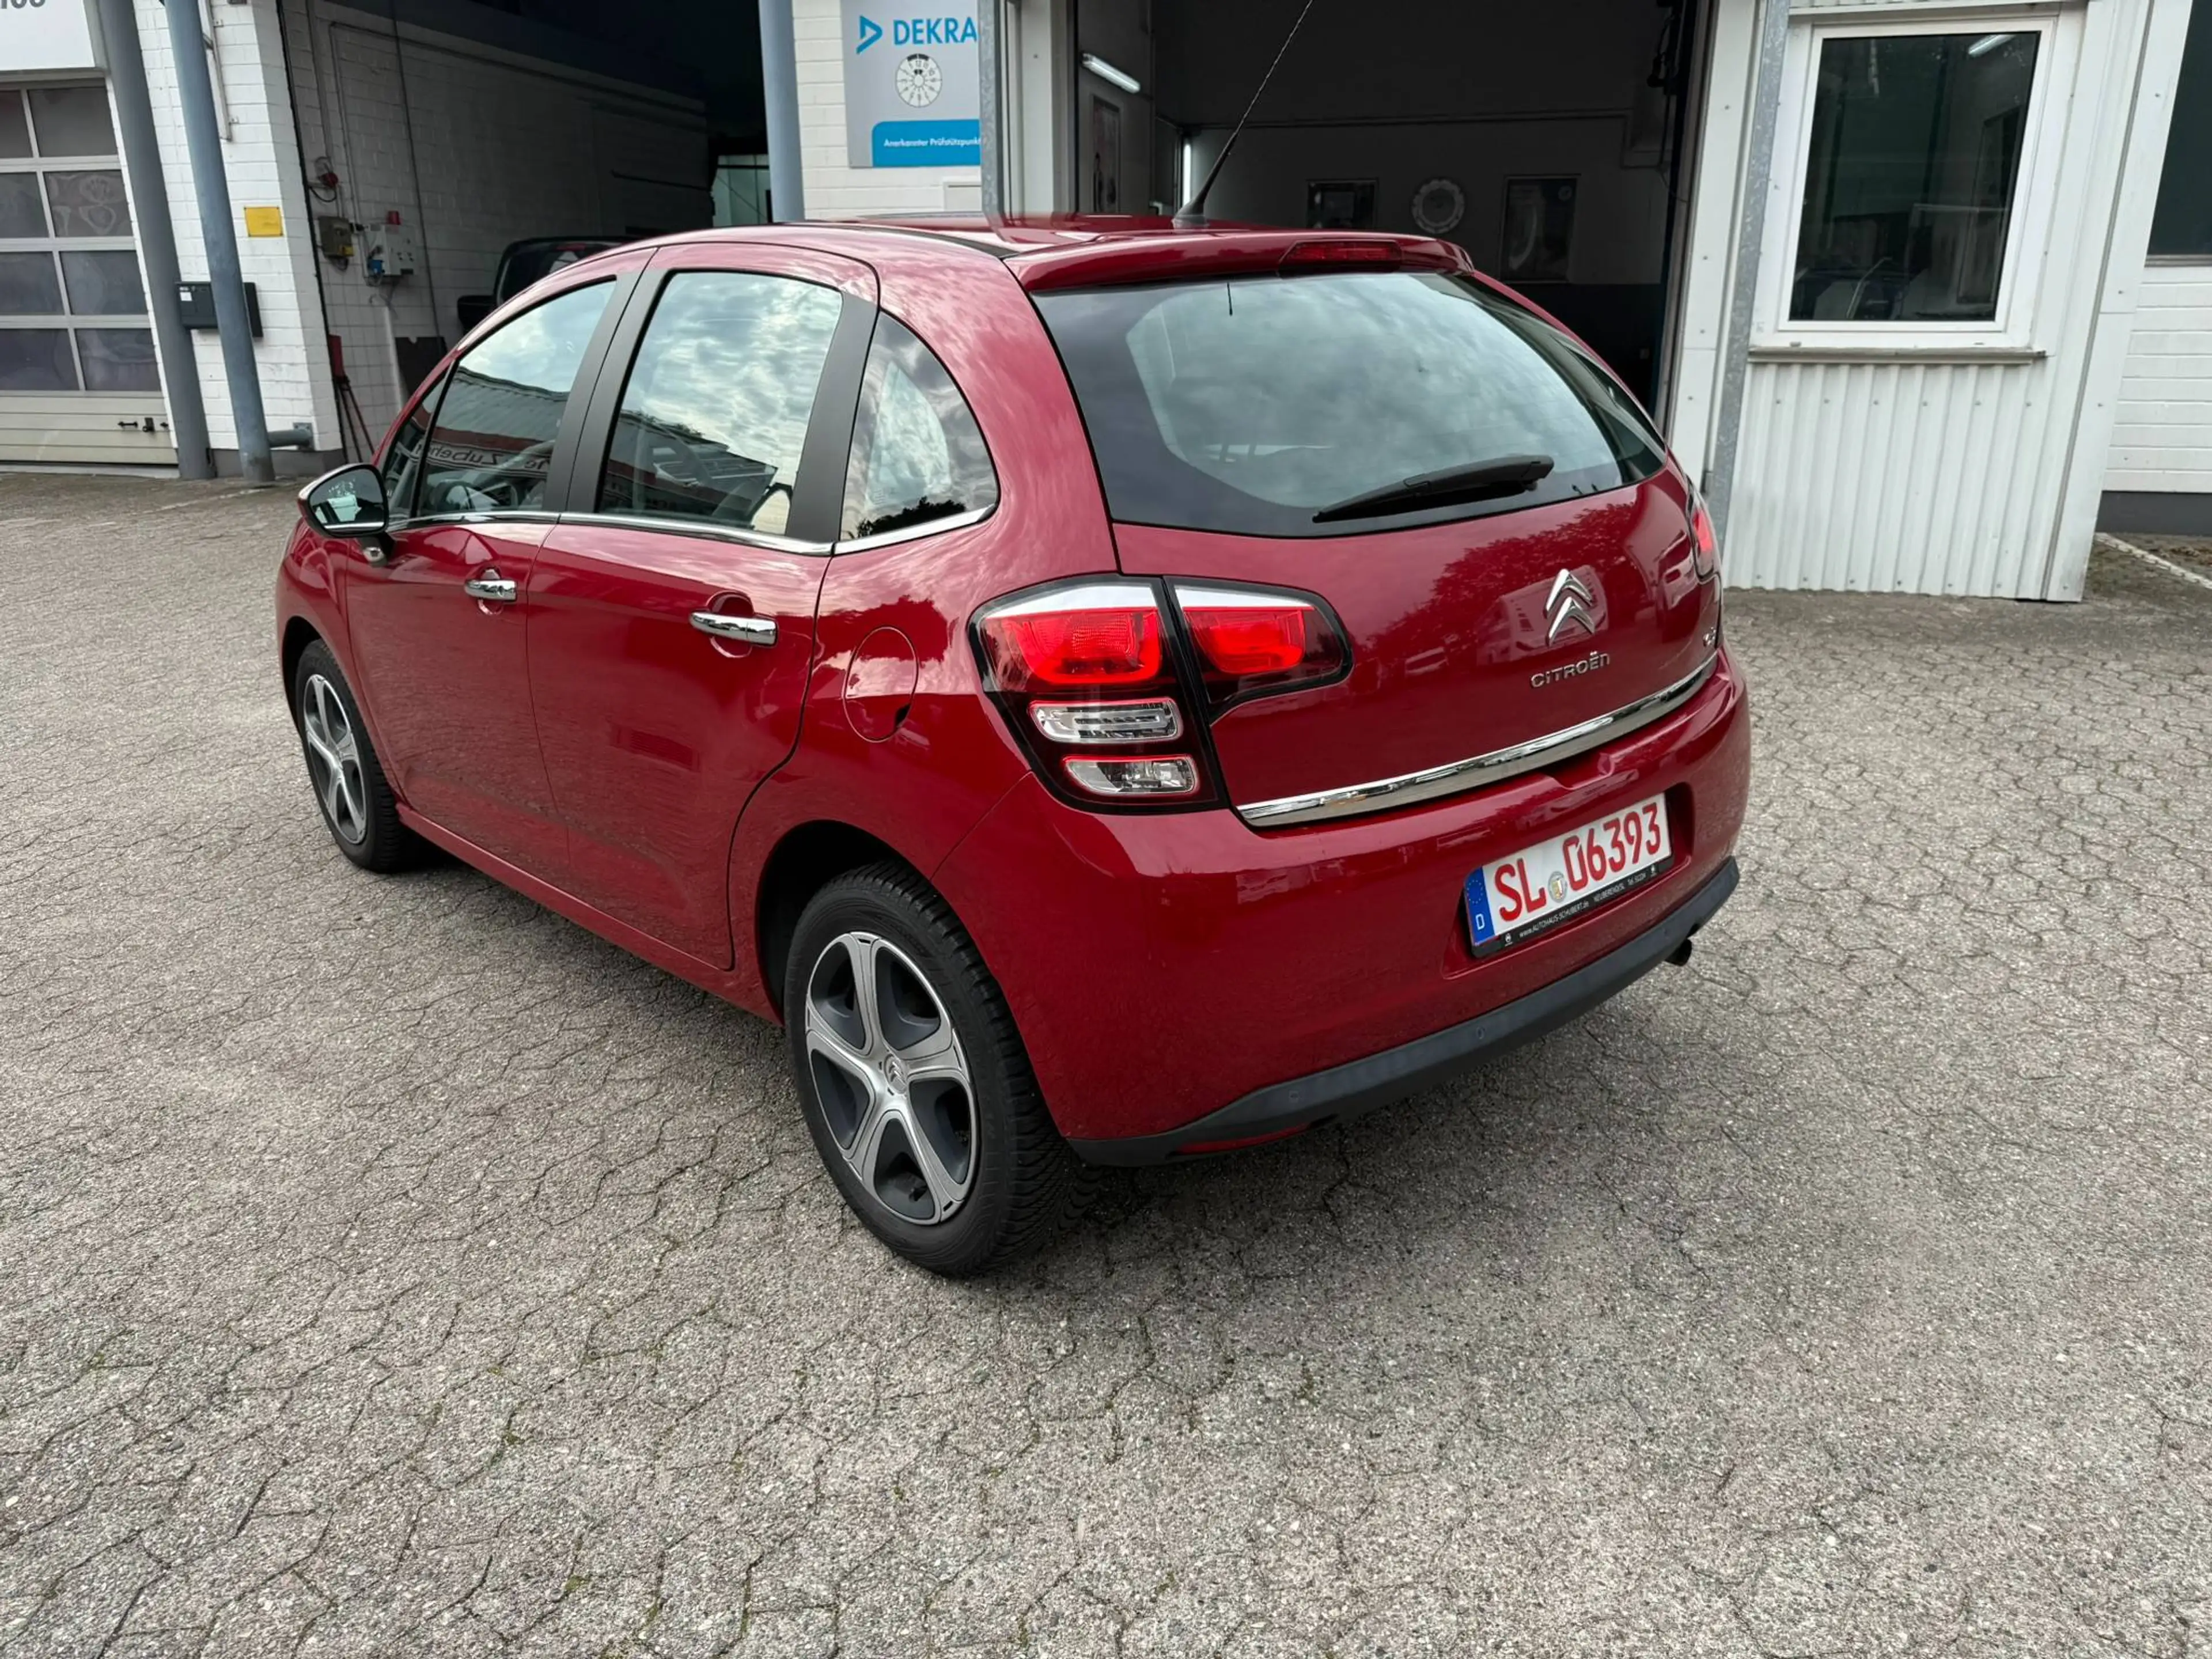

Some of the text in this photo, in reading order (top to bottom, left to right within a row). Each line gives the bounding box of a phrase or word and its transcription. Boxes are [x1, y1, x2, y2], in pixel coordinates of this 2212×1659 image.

[893, 17, 978, 46] DEKRA
[884, 138, 927, 147] Anerkannter
[1494, 802, 1661, 922] SL 06393
[1475, 914, 1485, 930] D
